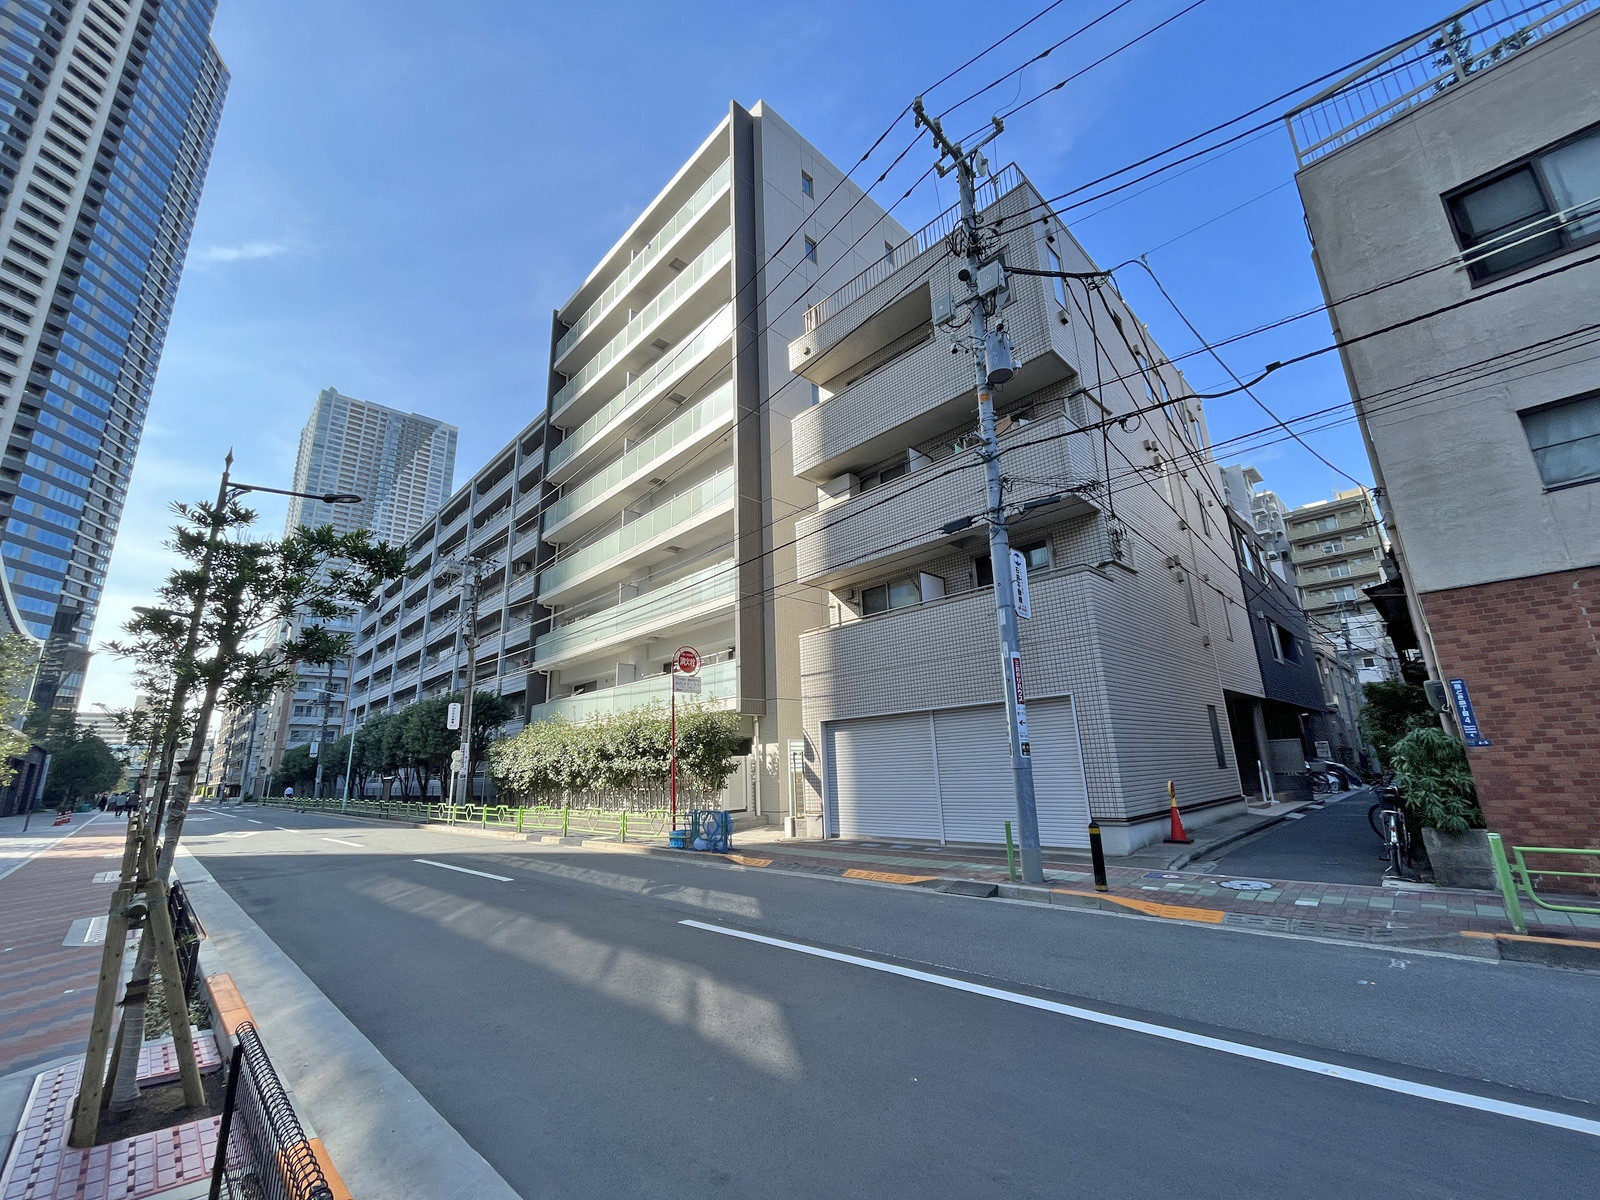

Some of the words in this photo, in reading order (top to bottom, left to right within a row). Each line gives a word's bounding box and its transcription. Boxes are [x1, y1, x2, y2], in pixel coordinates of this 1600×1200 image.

[680, 657, 695, 667] 消火栓
[1015, 661, 1024, 702] 三井のリハウス
